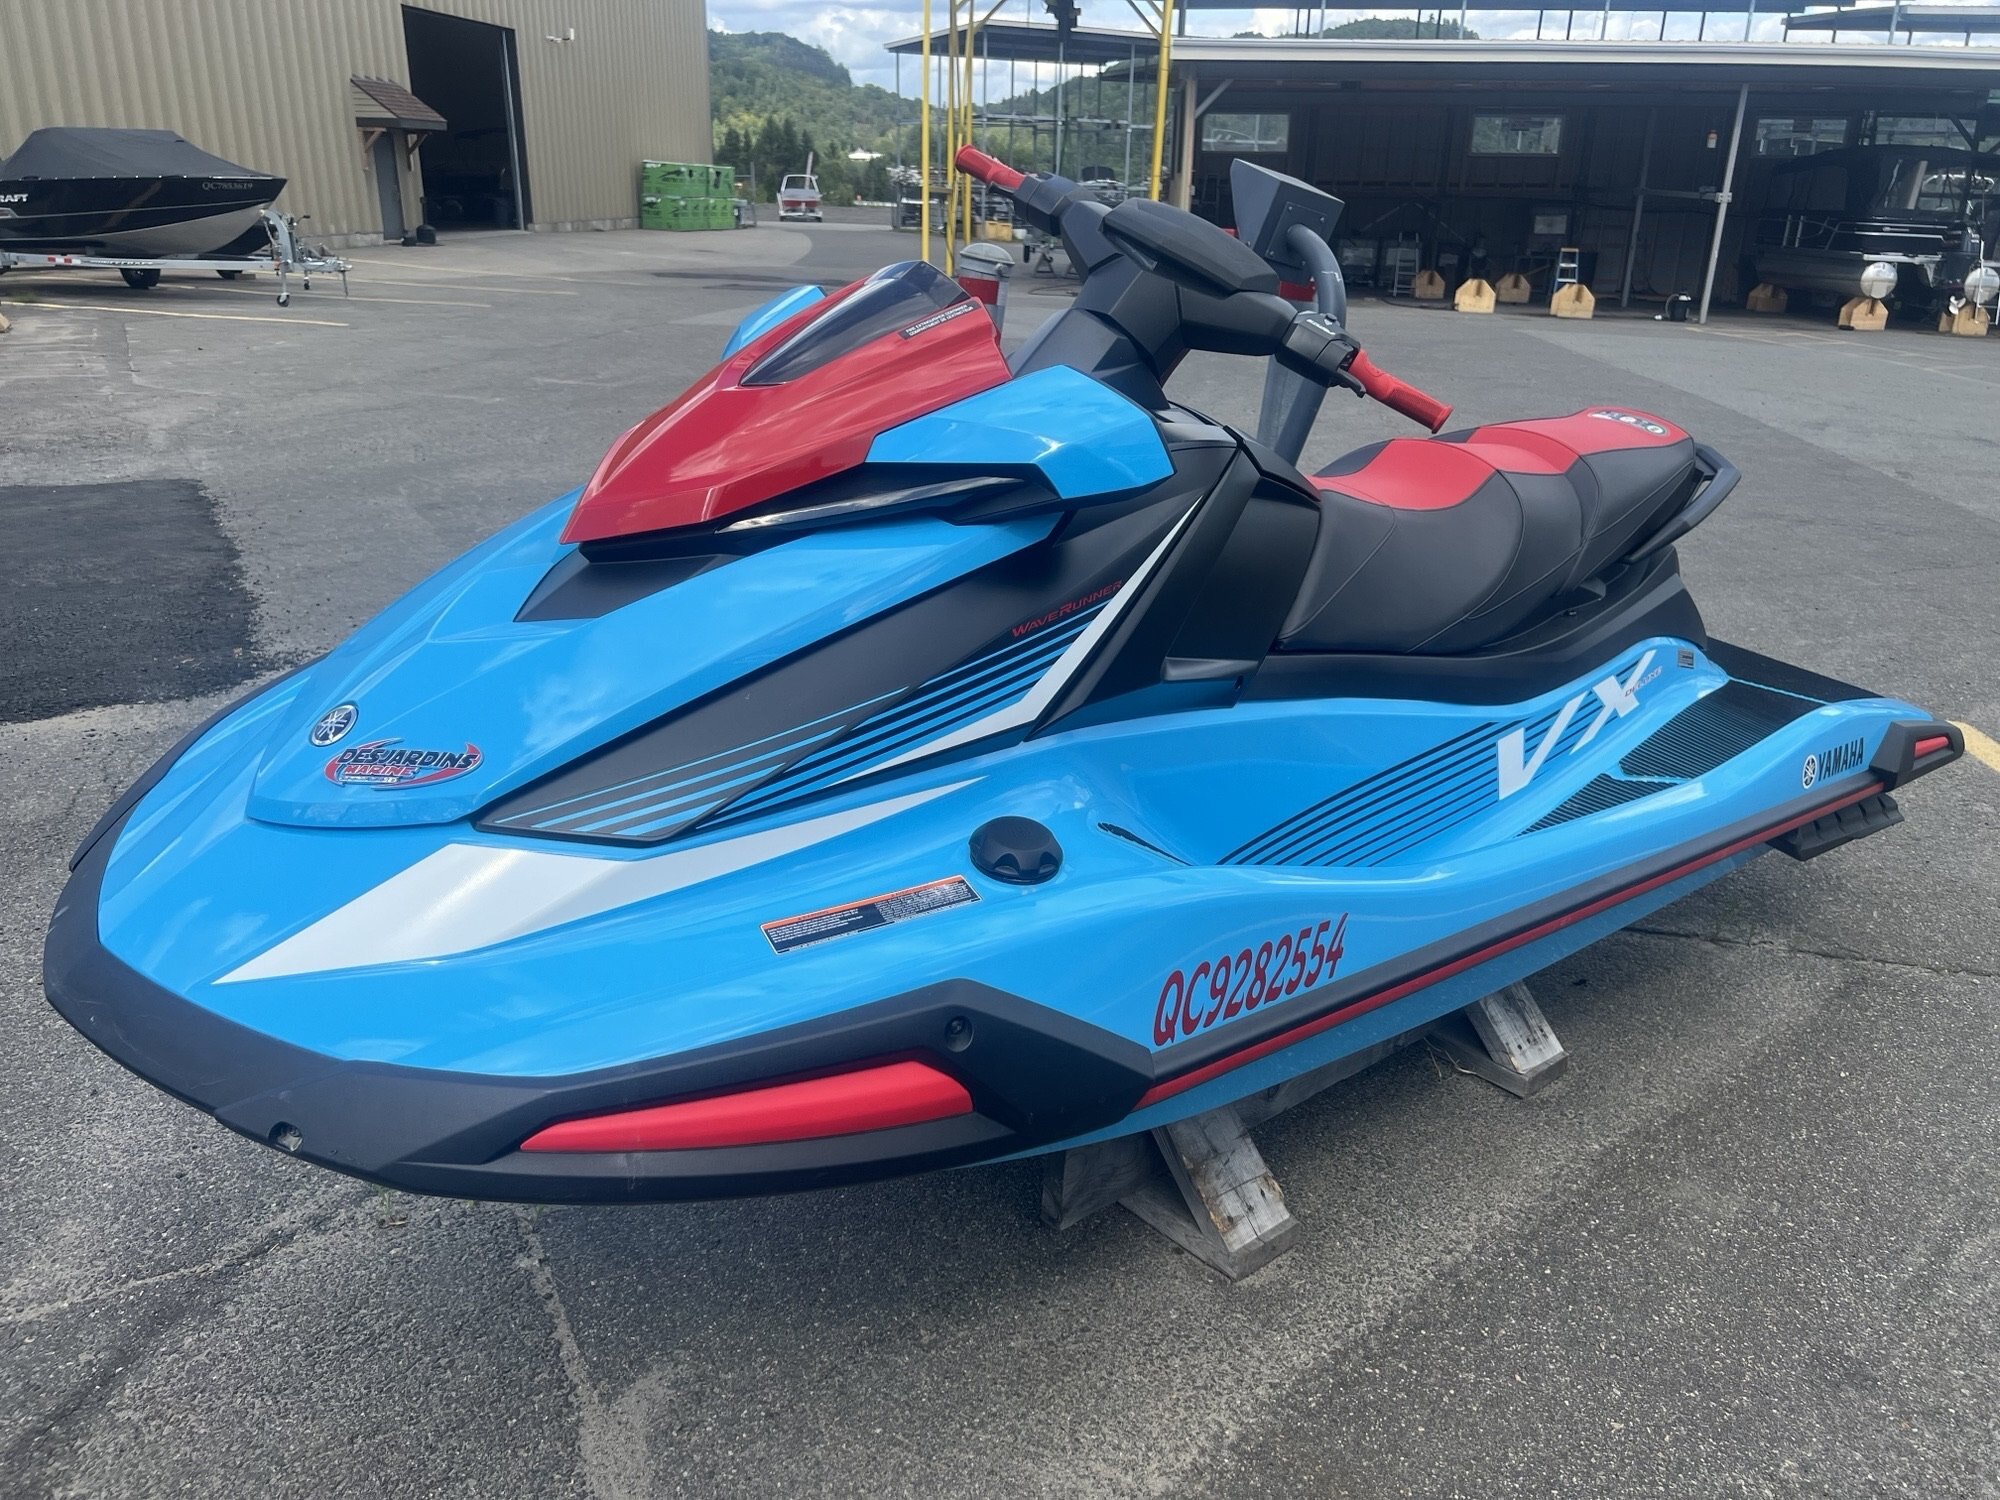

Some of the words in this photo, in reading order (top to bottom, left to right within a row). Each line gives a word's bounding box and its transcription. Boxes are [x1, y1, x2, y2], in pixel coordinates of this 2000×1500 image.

[1497, 649, 1657, 800] VX
[337, 748, 479, 769] DESJARDINS
[345, 764, 415, 777] MARINE
[1818, 737, 1864, 781] YAMAHA
[1153, 912, 1349, 1047] QC9282554
